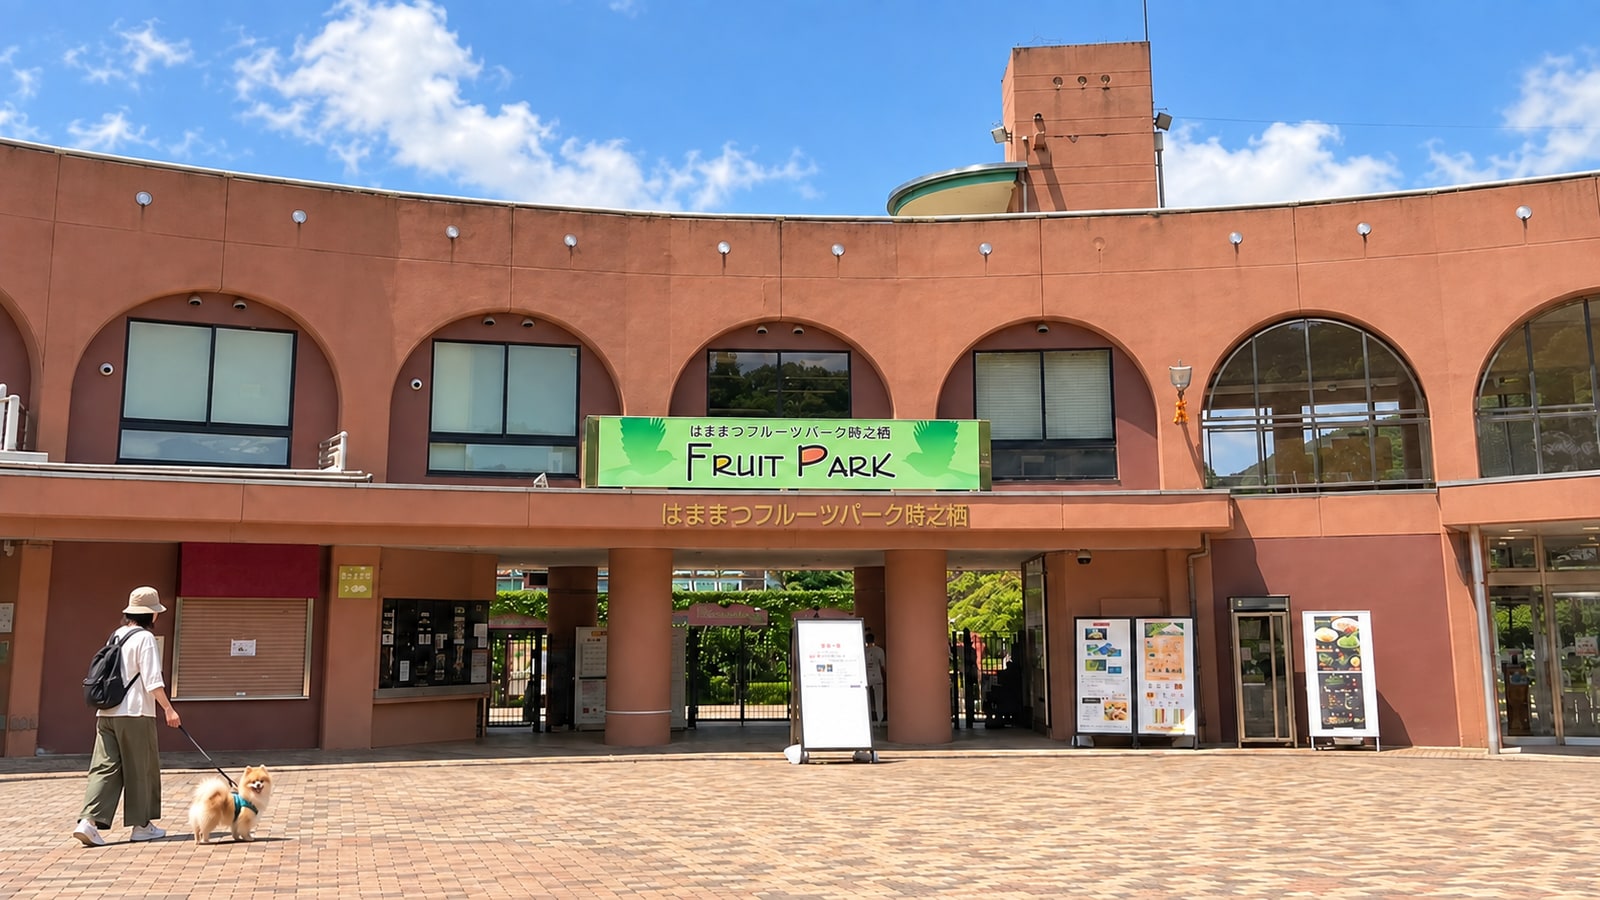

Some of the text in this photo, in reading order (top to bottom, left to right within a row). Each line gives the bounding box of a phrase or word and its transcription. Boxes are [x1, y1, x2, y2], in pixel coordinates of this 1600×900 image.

[687, 443, 896, 481] FRUIT PARK
[662, 503, 968, 528] はままつフルーツパーク時之栖
